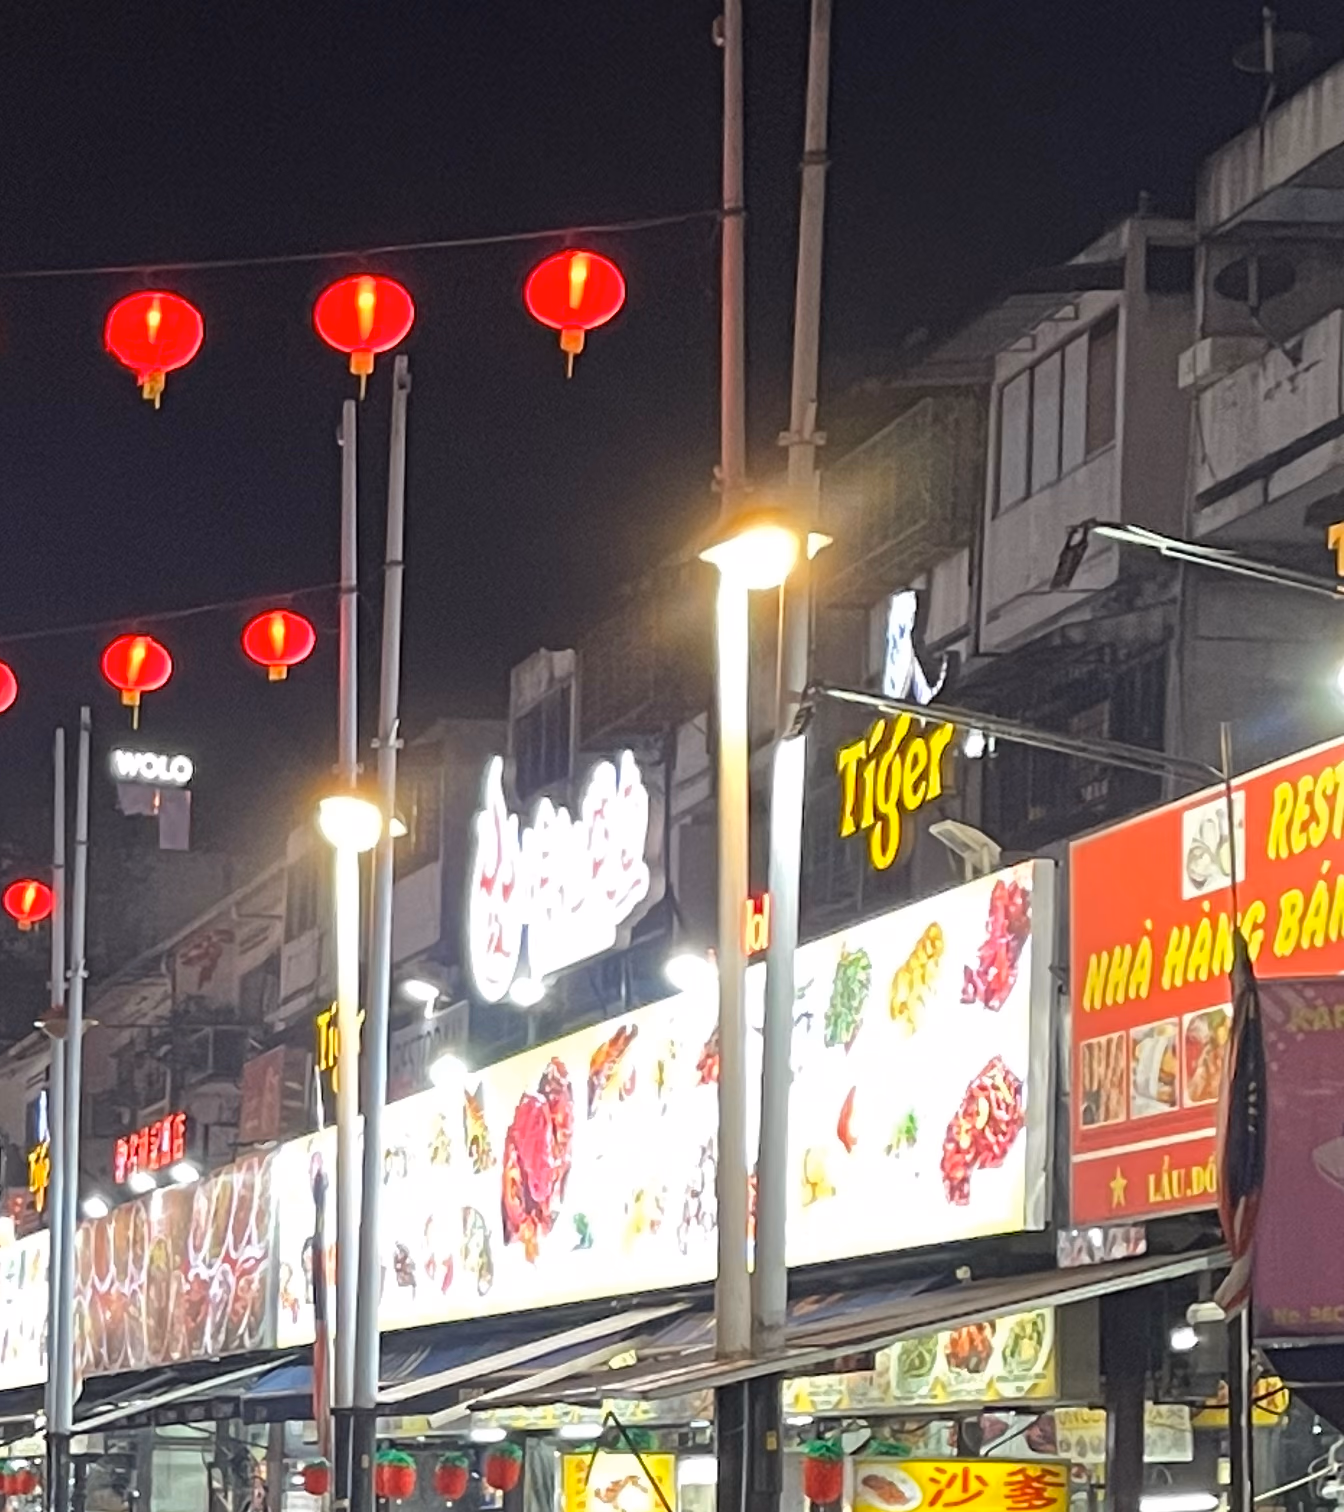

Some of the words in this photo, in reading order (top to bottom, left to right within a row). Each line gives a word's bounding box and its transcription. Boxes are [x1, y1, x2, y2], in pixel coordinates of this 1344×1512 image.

[114, 748, 193, 783] WOLO
[838, 711, 955, 870] Tiger
[1082, 919, 1154, 1012] NHÀ
[928, 1466, 1065, 1511] 沙爹
